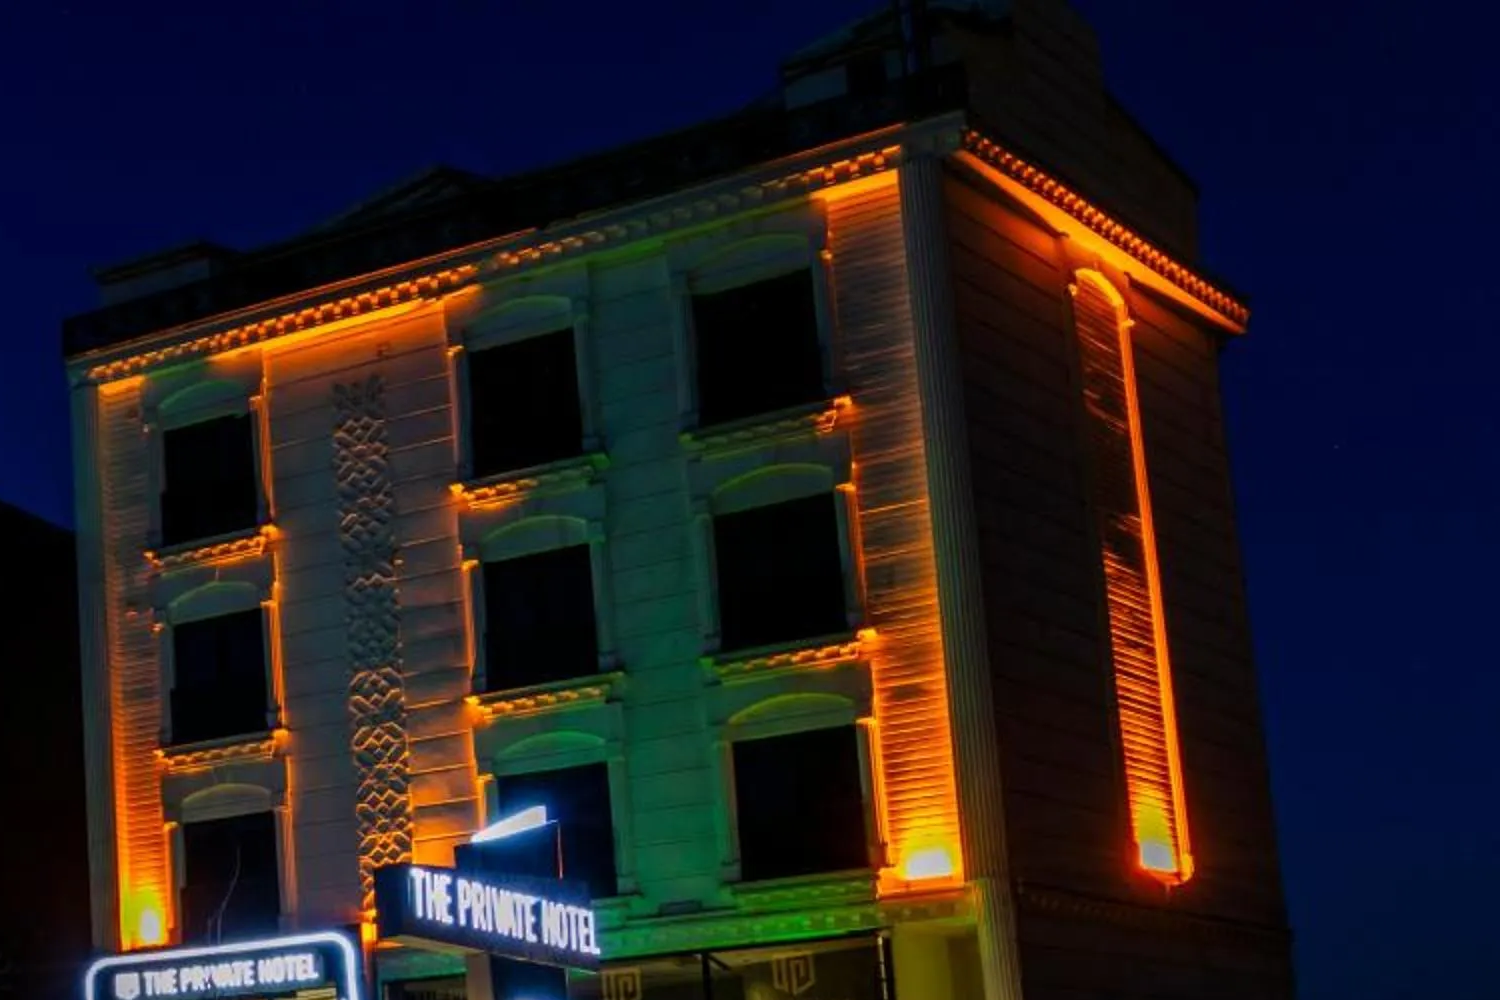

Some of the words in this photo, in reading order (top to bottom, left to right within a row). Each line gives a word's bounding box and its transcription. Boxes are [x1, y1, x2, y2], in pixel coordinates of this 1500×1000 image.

[410, 867, 454, 925] THE
[457, 878, 538, 943] PRIVATE
[541, 898, 601, 955] HOTEL
[143, 967, 178, 996] THE
[180, 960, 255, 992] PRIVATE
[257, 953, 319, 984] HOTEL
